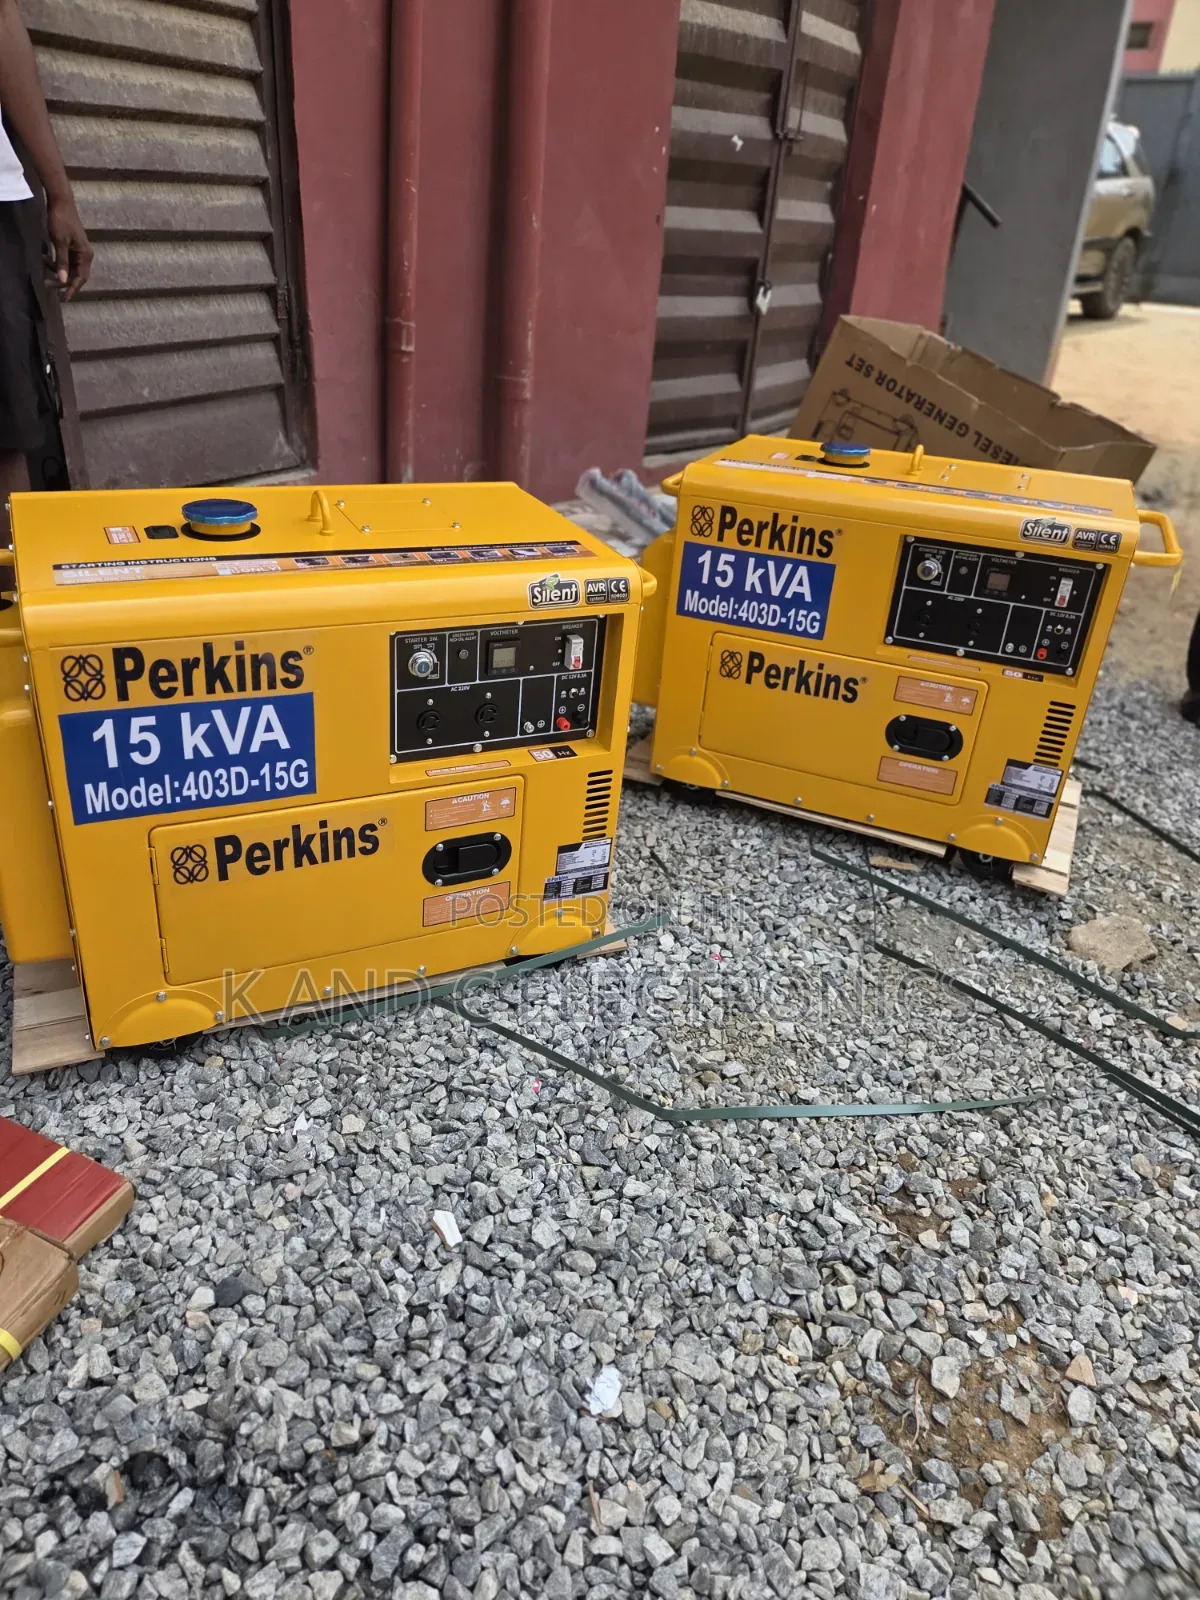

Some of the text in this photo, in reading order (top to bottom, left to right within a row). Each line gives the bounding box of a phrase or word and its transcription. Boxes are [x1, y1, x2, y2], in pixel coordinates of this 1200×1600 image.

[845, 353, 1021, 465] IESEL GENERATOR SET
[1024, 522, 1068, 540] Silent
[1076, 531, 1095, 540] AVR
[61, 561, 125, 569] STARTING
[127, 556, 217, 565] INSTRUCTIONS
[698, 550, 812, 603] 15 kVA
[533, 583, 577, 603] Silent
[587, 582, 606, 593] AVR
[684, 589, 821, 634] Model:403D-15G
[92, 704, 291, 769] 15 kVA
[533, 750, 552, 760] 50
[84, 758, 309, 815] Model:403D-15G
[458, 792, 489, 803] CAUTION
